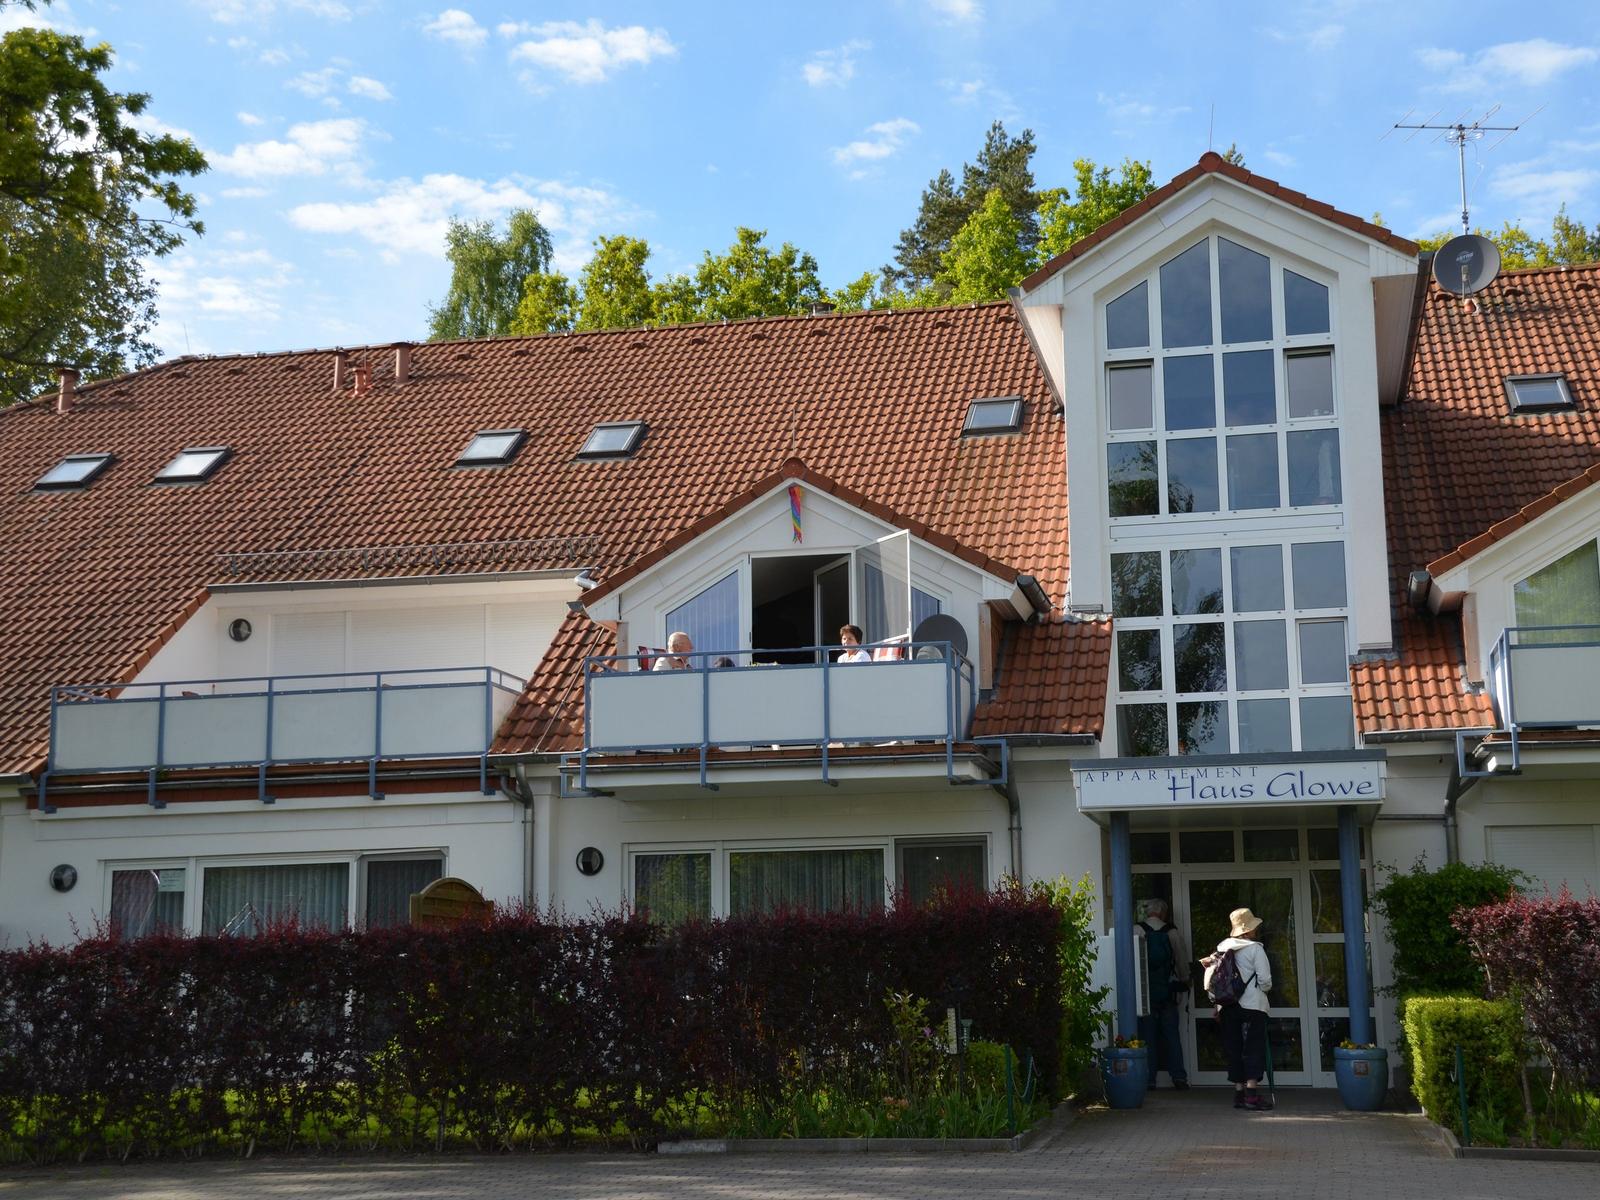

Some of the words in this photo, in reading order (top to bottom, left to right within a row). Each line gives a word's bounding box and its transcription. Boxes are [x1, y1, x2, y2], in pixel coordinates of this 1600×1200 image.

[1084, 766, 1258, 783] APPARTEMENT
[1167, 775, 1254, 801] Haus
[1266, 770, 1375, 798] Glowe
